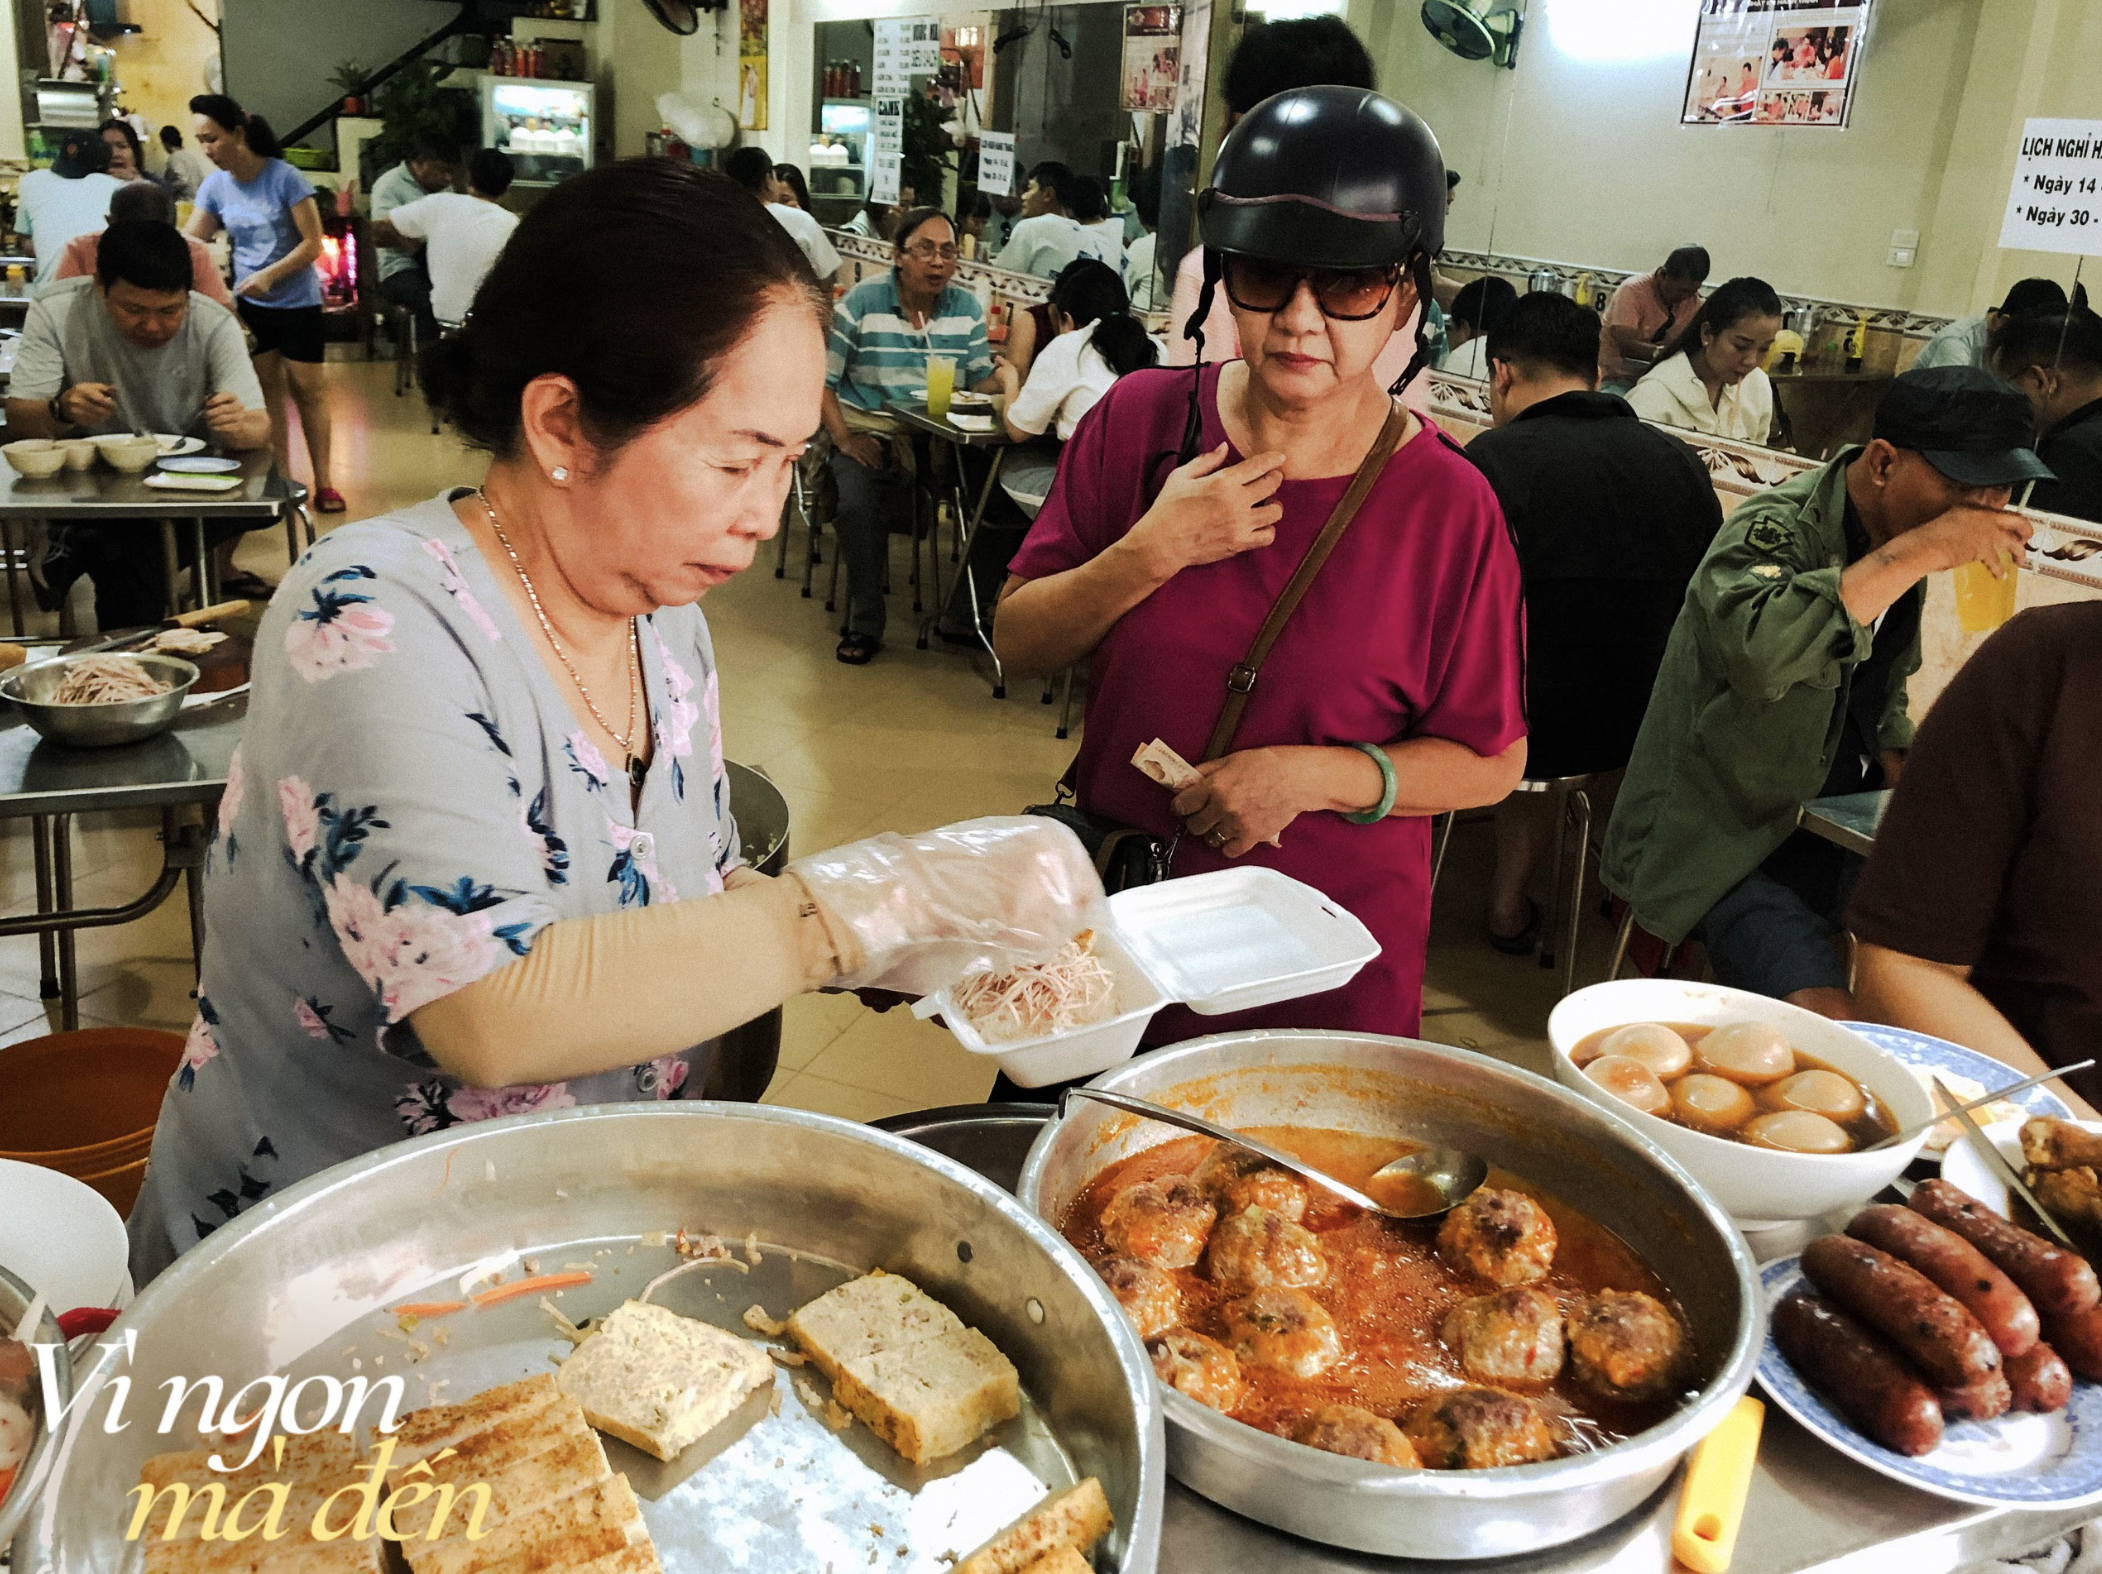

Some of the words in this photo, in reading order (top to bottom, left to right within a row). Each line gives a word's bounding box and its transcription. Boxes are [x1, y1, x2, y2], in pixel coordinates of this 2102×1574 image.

[2022, 137, 2053, 161] LỊCH
[2056, 132, 2092, 158] NGHỈ
[2092, 139, 2102, 159] H
[2033, 175, 2073, 195] Ngày
[2079, 177, 2097, 194] 14
[2026, 206, 2065, 227] Ngày
[2070, 209, 2090, 226] 30
